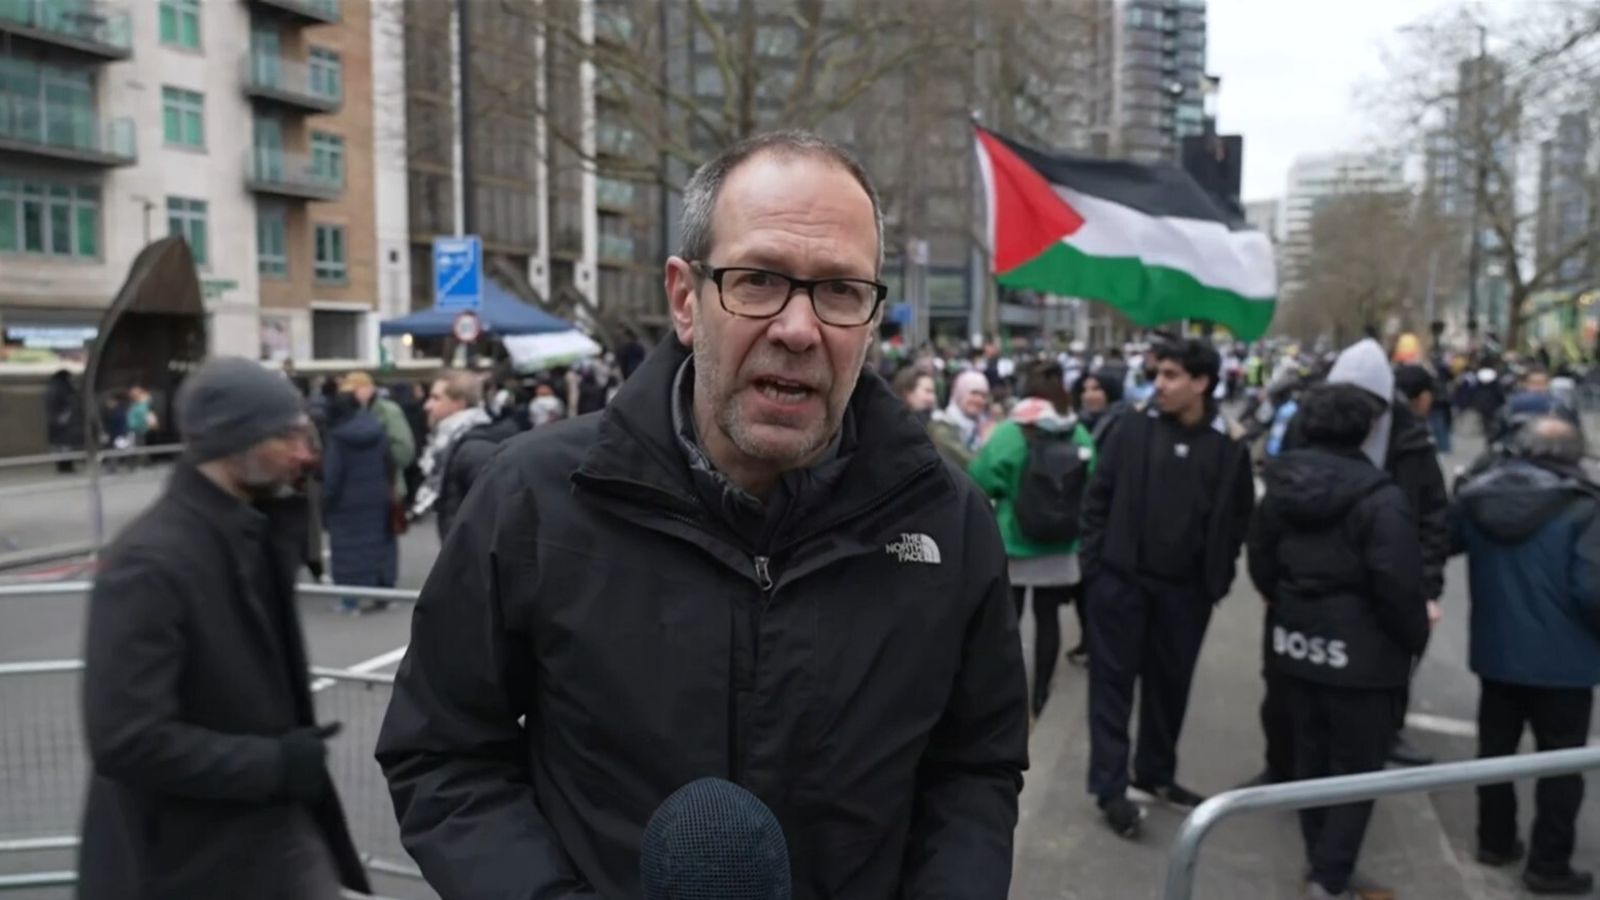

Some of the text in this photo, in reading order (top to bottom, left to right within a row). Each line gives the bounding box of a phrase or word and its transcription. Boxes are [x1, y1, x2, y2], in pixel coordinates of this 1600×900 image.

[901, 533, 921, 543] THE
[885, 543, 922, 554] NORTH
[899, 552, 924, 562] FACE
[1273, 626, 1349, 668] BOSS
